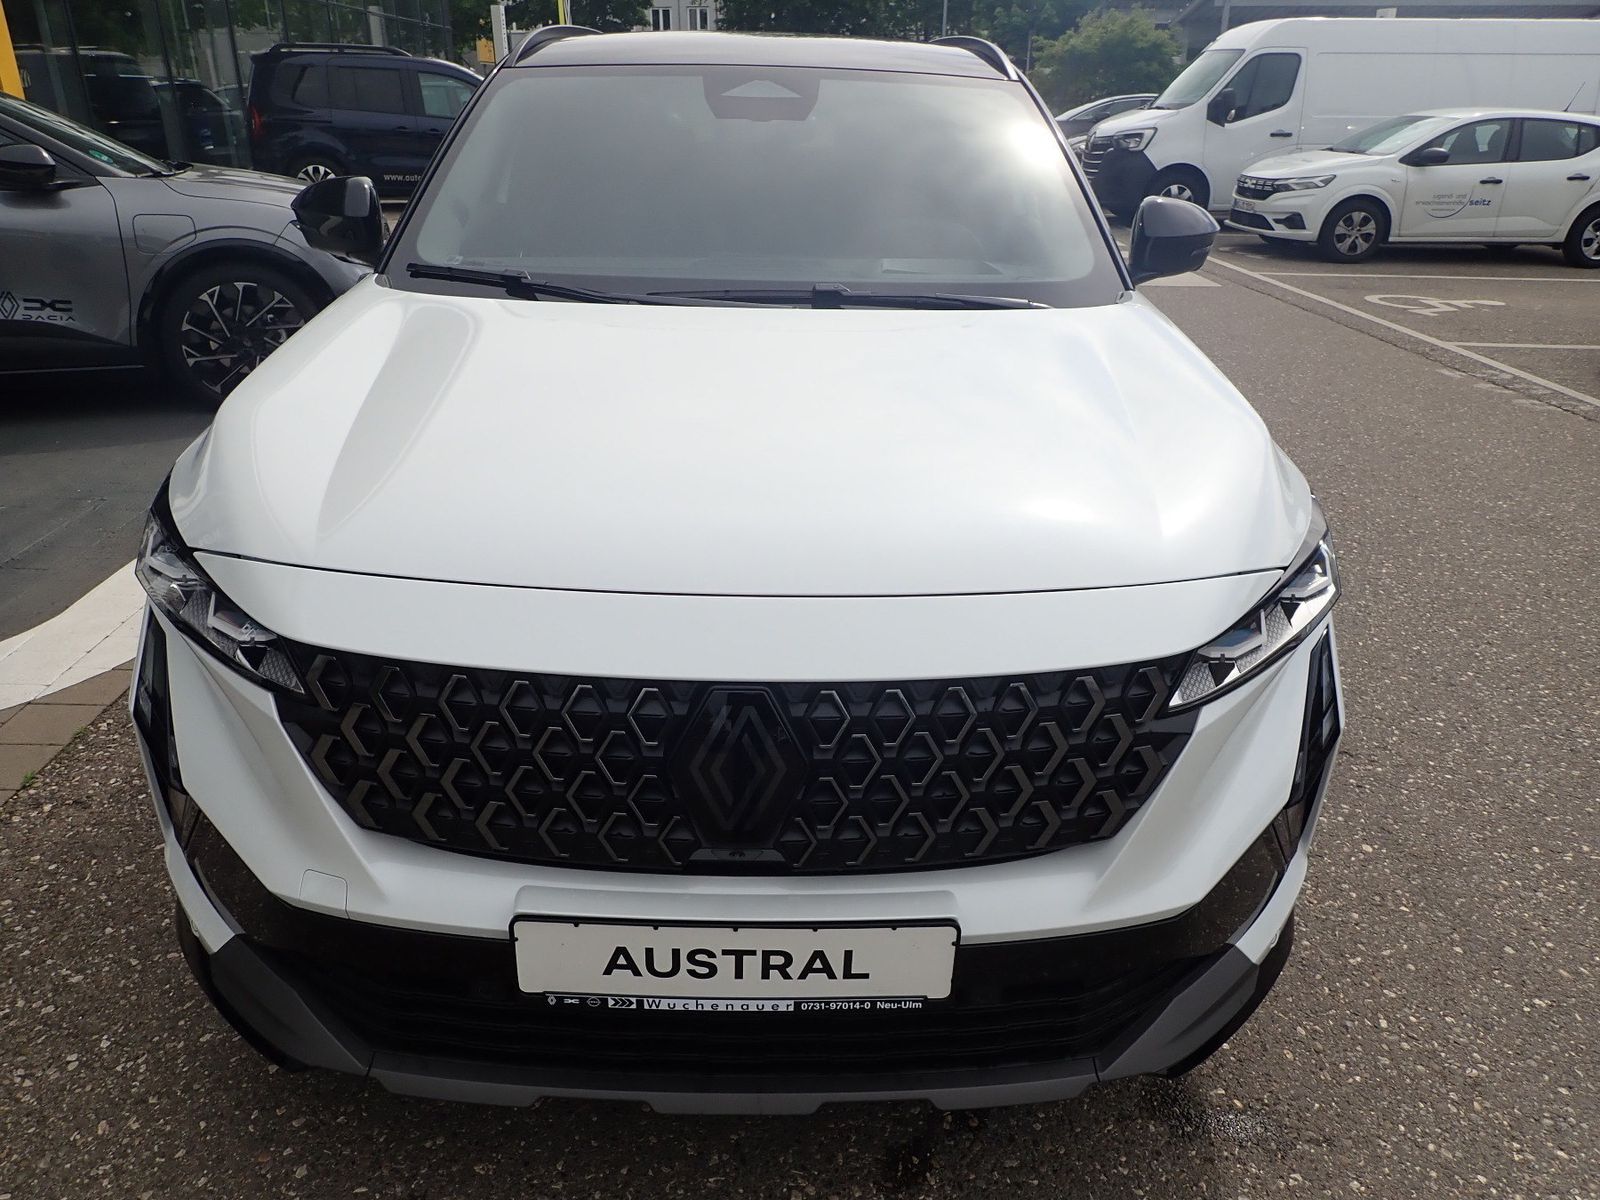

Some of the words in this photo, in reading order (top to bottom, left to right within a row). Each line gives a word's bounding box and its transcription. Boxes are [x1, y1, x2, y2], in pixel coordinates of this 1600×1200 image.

[1469, 198, 1492, 206] seitz
[602, 946, 870, 980] AUSTRAL
[647, 998, 794, 1011] Wuchenauer
[801, 1001, 871, 1010] 0731-97014-0
[876, 1001, 922, 1010] Neu-Ulm
